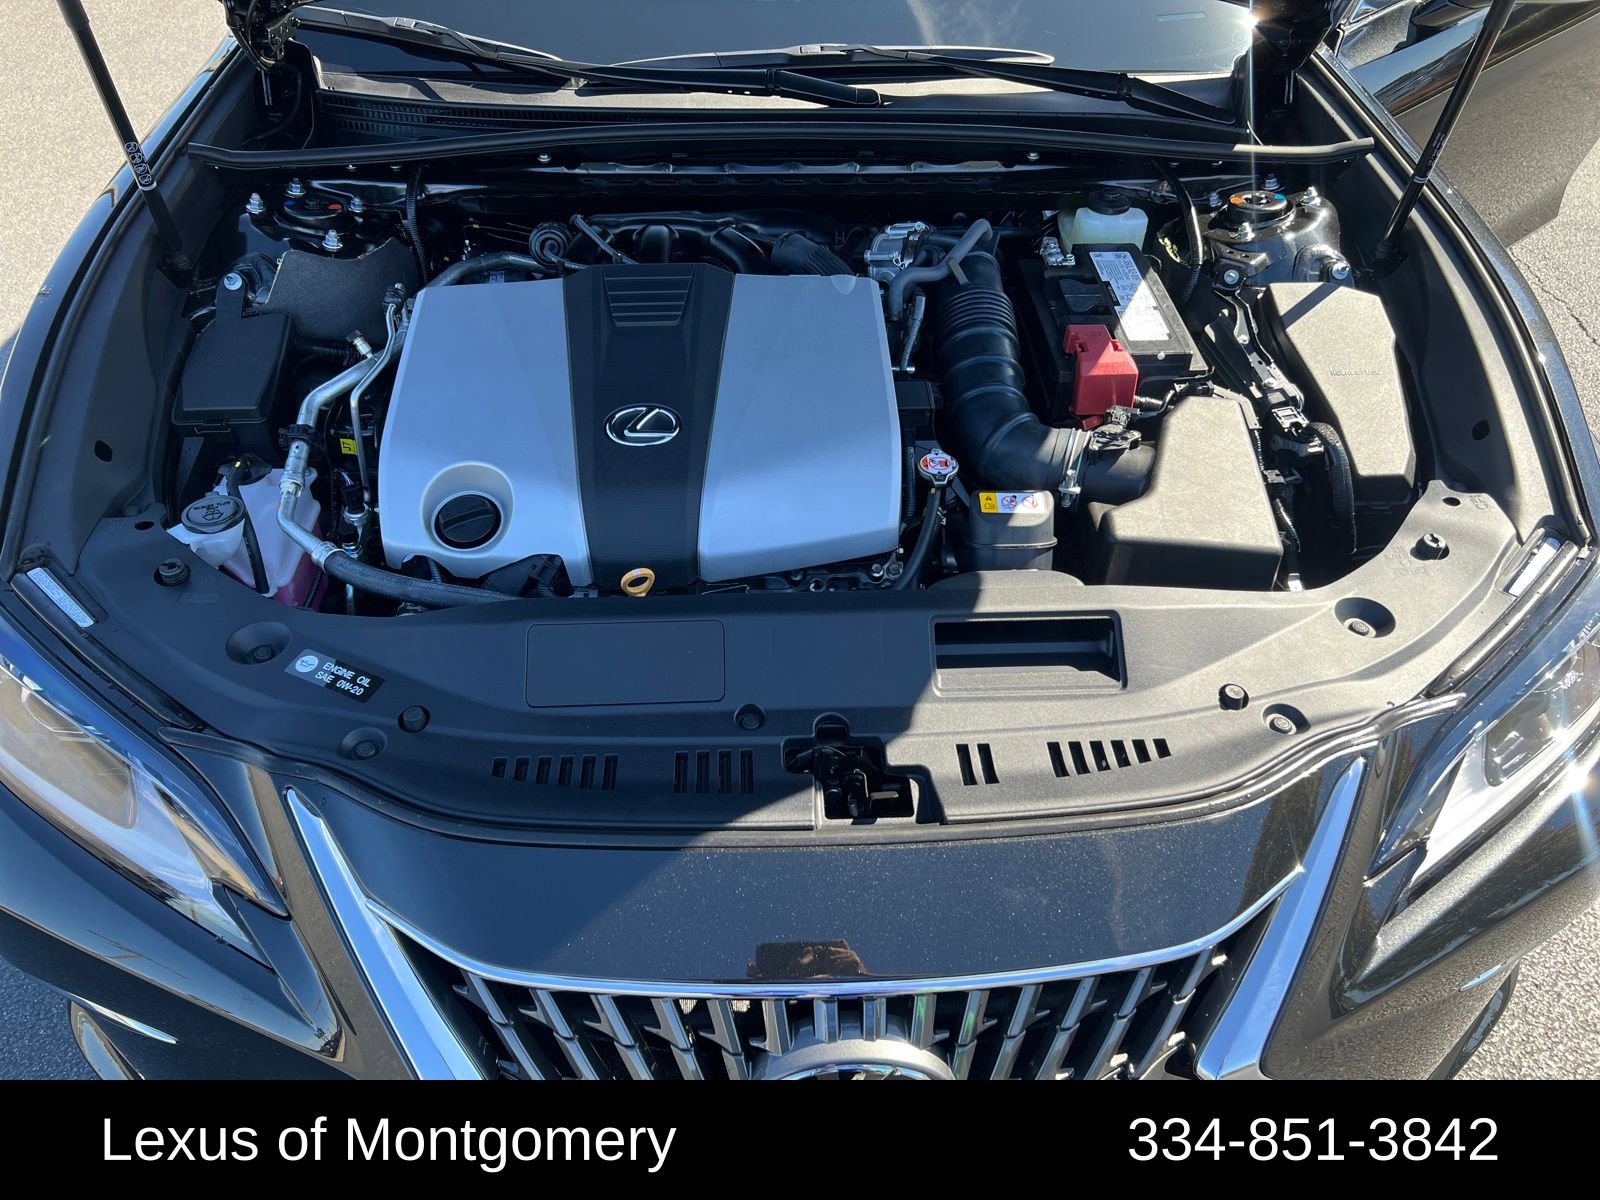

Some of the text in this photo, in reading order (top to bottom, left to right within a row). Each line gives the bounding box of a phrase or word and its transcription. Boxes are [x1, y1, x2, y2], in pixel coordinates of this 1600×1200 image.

[315, 671, 364, 696] SAE 0W-20
[322, 662, 371, 688] ENGINE OIL
